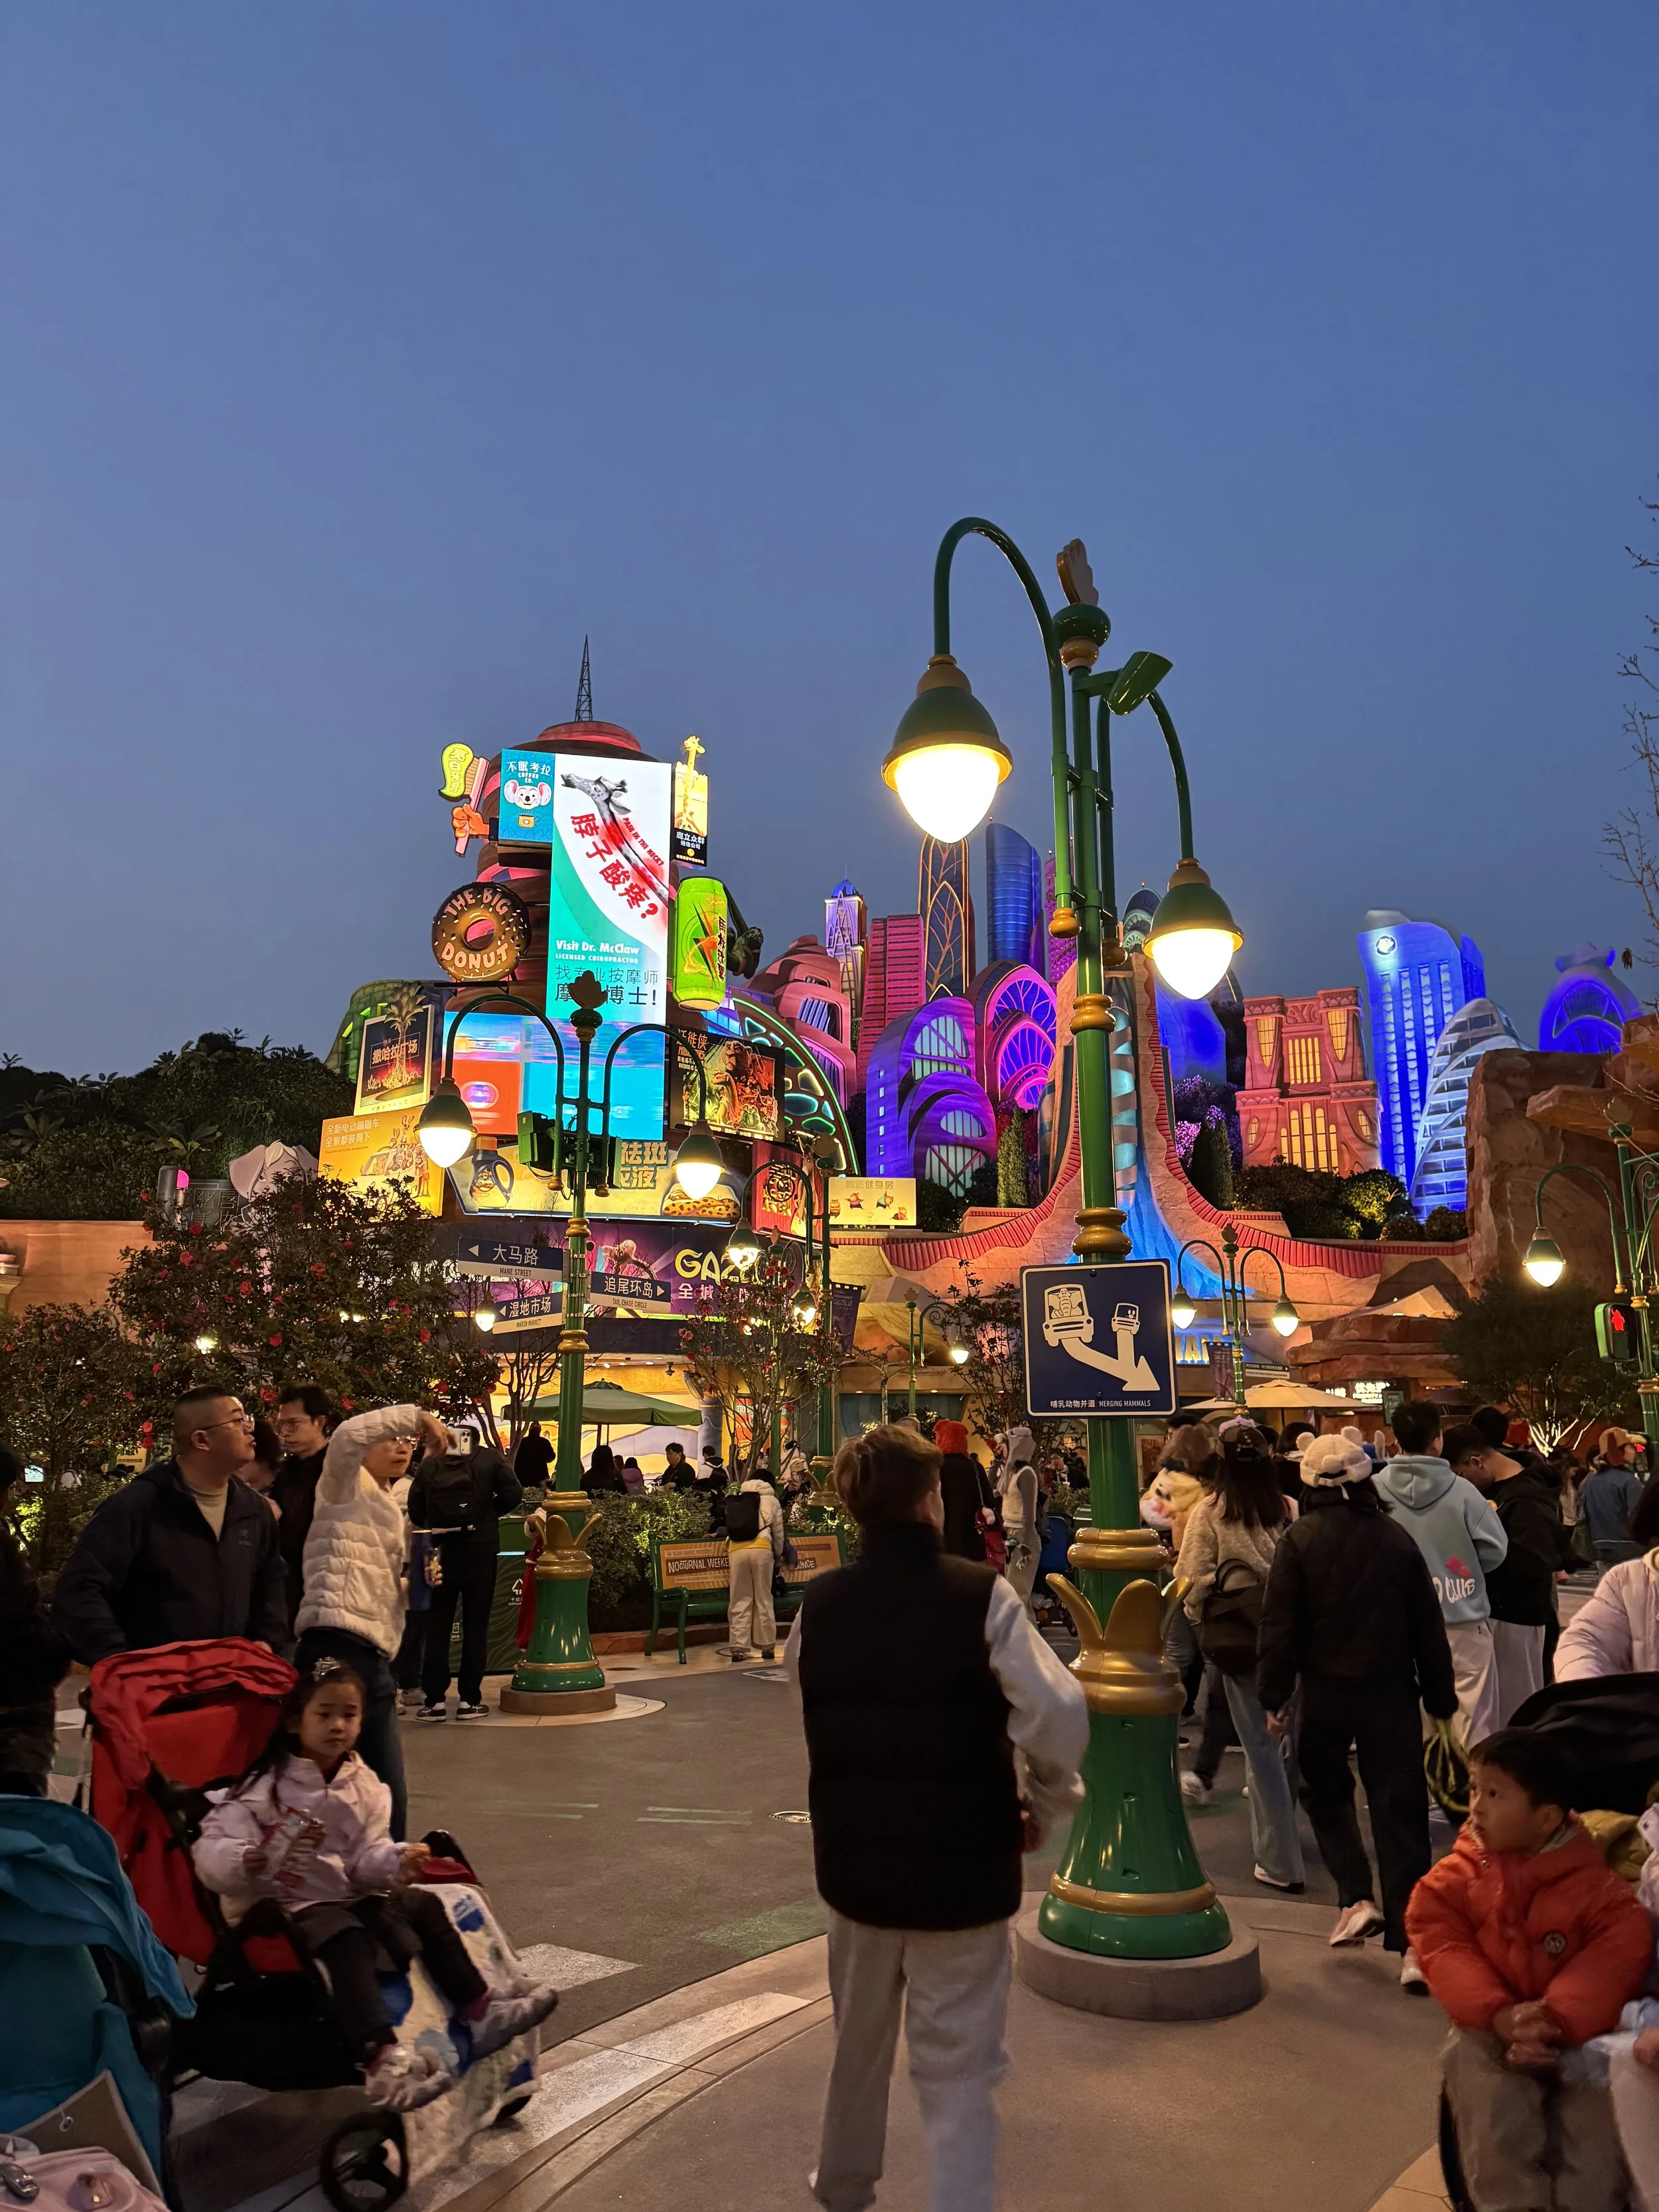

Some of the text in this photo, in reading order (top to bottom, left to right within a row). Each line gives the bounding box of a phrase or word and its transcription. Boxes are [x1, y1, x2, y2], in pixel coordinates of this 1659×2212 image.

[506, 761, 553, 776] 不眠考拉
[623, 818, 634, 832] PAIN
[638, 838, 649, 850] THE
[646, 848, 664, 866] NECK?
[570, 813, 658, 919] 脖子酸疼?
[443, 887, 512, 916] THE BIG
[555, 940, 640, 954] Visit Dr. McClaw
[441, 942, 509, 969] DONUT
[588, 954, 638, 964] CHIROPRACTOR
[325, 1132, 371, 1147] 全家都装得下
[492, 1243, 539, 1266] 大马路
[500, 1267, 513, 1276] MANE
[604, 1276, 653, 1298] 追尾环岛
[508, 1296, 551, 1318] 湿地市场
[622, 1299, 634, 1307] CHASE
[1050, 1400, 1096, 1408] 哺乳动物并道
[668, 1558, 729, 1574] NOCTURNAL WEEKE
